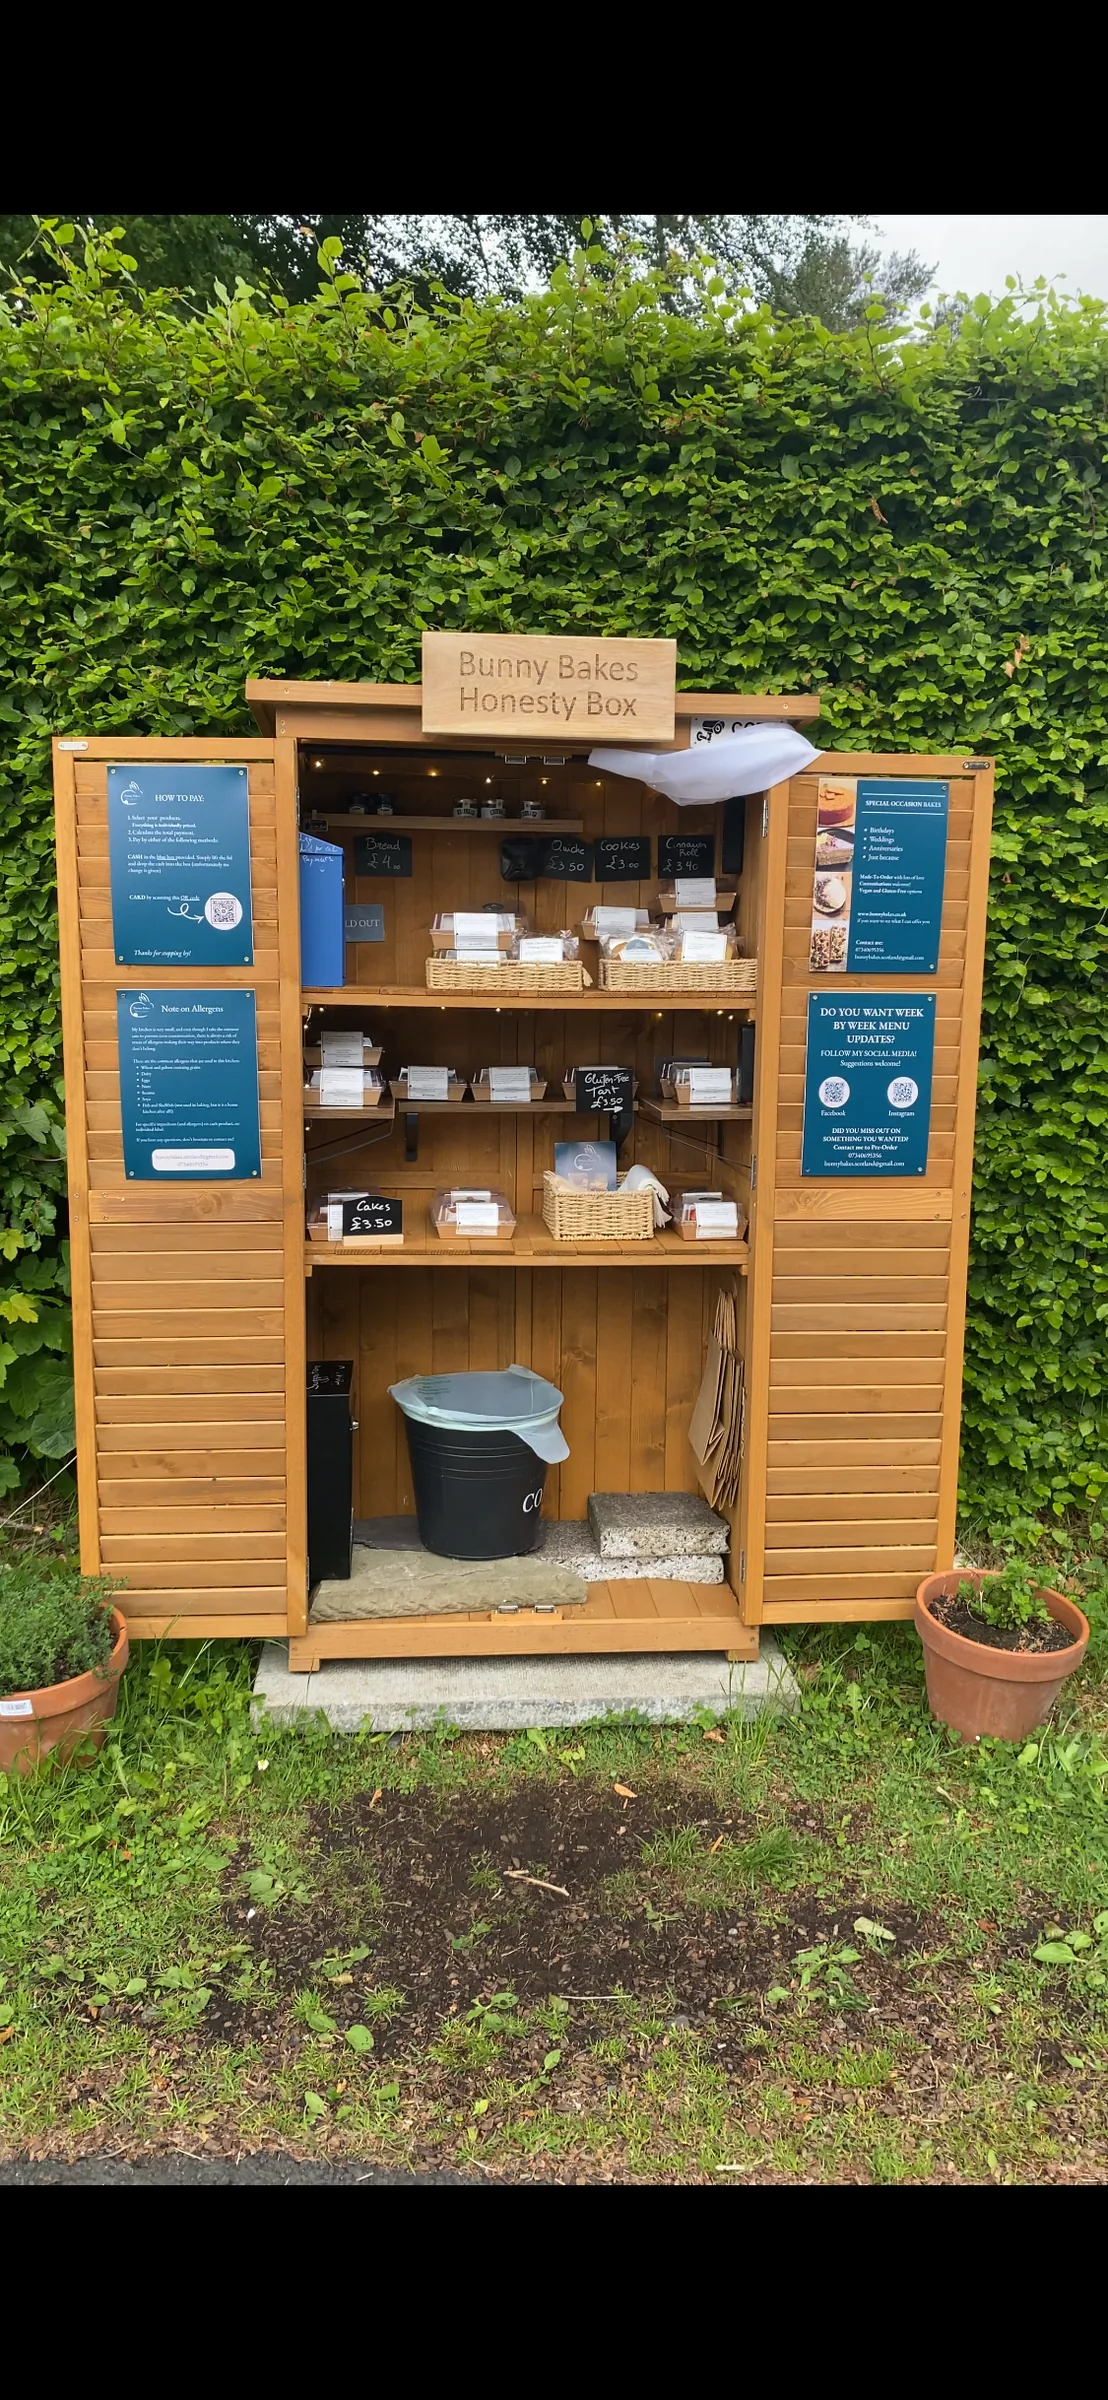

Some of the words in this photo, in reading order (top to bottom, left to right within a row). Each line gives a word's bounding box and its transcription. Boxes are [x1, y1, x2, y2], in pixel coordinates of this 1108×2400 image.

[460, 651, 549, 685] Bunny
[559, 654, 639, 681] Bakes
[460, 687, 577, 721] Honesty
[588, 691, 637, 716] Box
[870, 827, 894, 835] Birthdays
[366, 837, 400, 850] Bread
[600, 840, 640, 851] Cookies
[870, 836, 894, 844] Weddings
[552, 840, 585, 855] Quiche
[606, 855, 639, 870] £3.00
[345, 920, 357, 928] LD
[359, 920, 380, 928] OUT
[161, 1005, 179, 1013] Note
[192, 1005, 224, 1014] Allergens
[820, 1008, 836, 1016] DO
[839, 1008, 860, 1017] YOU
[863, 1008, 894, 1017] WANT
[895, 1009, 924, 1017] WEEK
[834, 1022, 846, 1030] BY
[848, 1022, 877, 1030] WEEK
[878, 1022, 910, 1030] MENU
[847, 1035, 895, 1043] UPDATES?
[840, 1060, 873, 1068] Suggestions
[585, 1086, 619, 1098] Tart
[591, 1096, 623, 1108] £3.50
[889, 1110, 914, 1118] Instagram
[357, 1200, 390, 1212] Cakes
[350, 1216, 392, 1231] £3.50
[523, 1488, 542, 1513] CO
